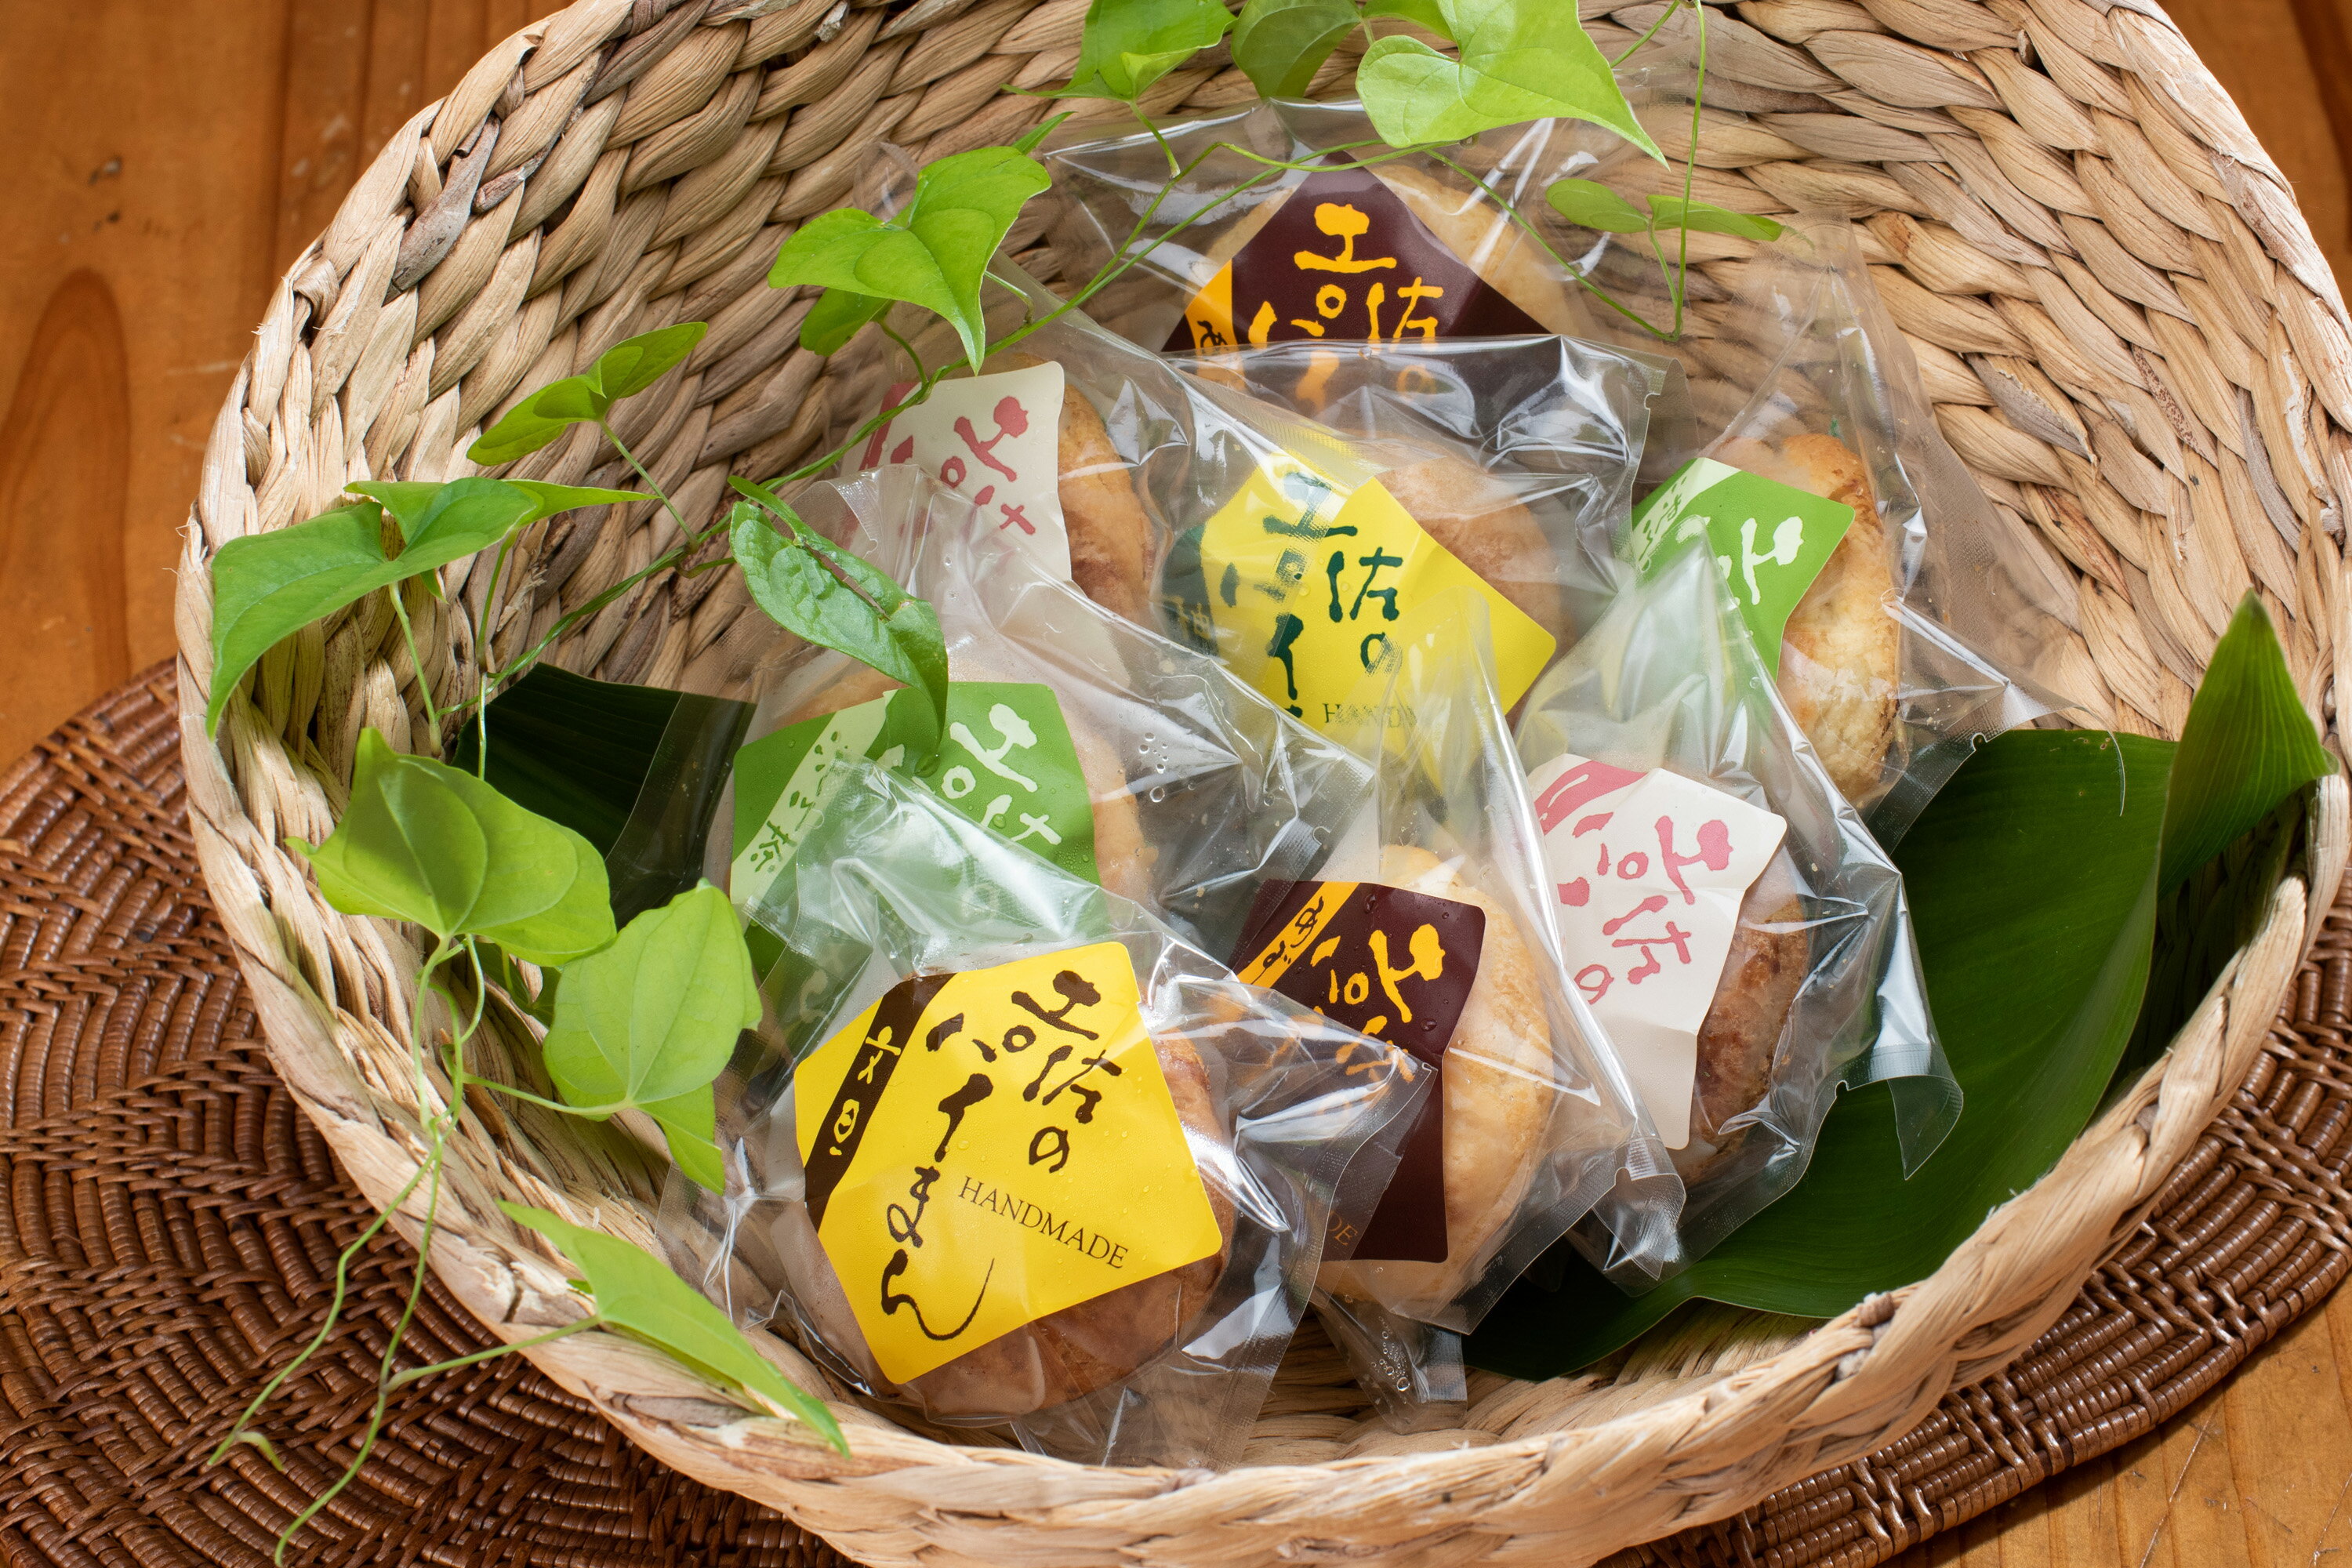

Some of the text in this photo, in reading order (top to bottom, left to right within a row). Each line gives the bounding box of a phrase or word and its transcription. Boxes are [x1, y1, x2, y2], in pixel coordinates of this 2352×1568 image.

[1011, 970, 1123, 1173] 土佐の
[959, 1175, 1130, 1270] HANDMADE
